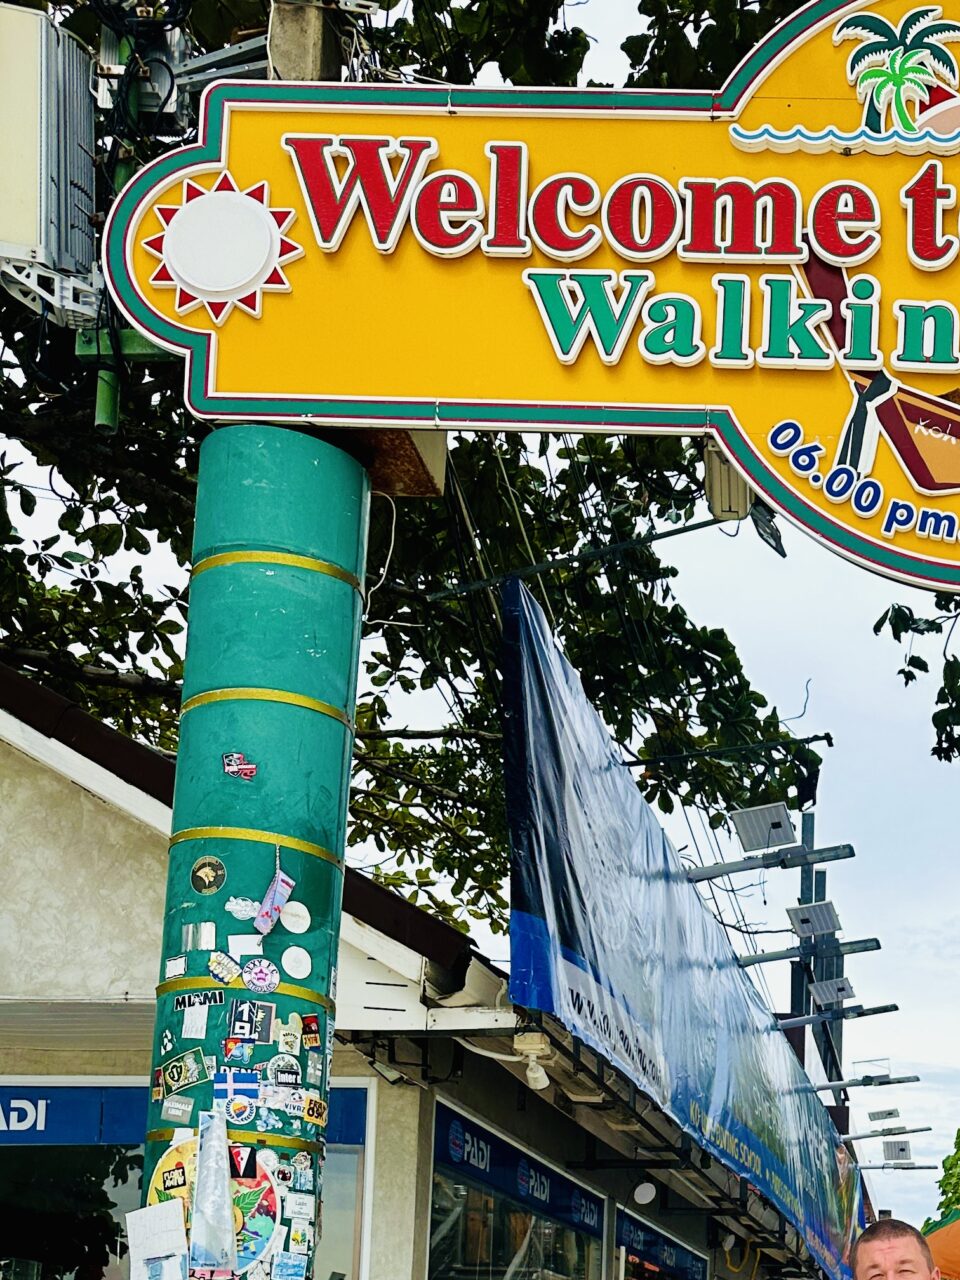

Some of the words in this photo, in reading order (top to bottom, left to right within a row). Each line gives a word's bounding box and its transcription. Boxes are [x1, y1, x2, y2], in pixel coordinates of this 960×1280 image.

[281, 133, 882, 269] Welcome
[914, 417, 957, 446] Koh
[767, 419, 884, 519] 06.00
[464, 1131, 491, 1172] PADI
[529, 1168, 550, 1204] PADI
[580, 1197, 598, 1229] PADI
